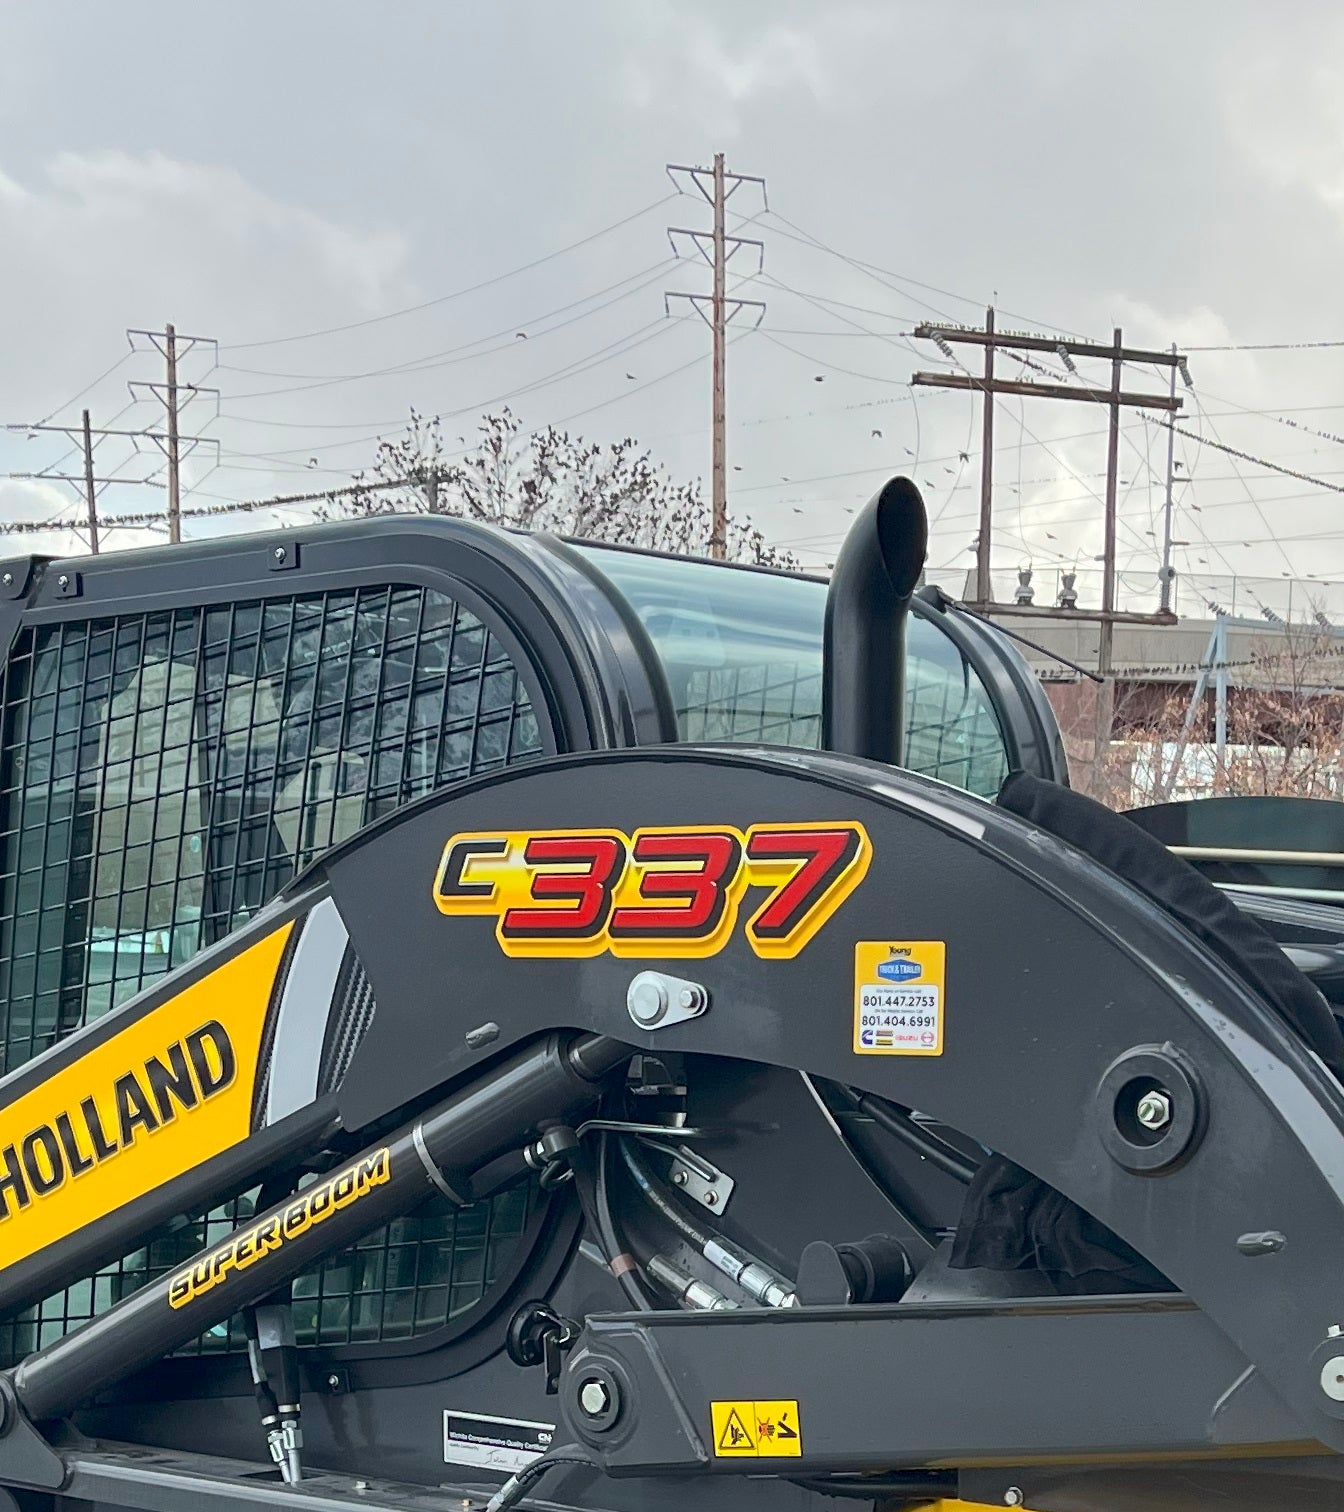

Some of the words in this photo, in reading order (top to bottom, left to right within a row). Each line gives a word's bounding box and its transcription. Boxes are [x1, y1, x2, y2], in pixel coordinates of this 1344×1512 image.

[434, 826, 868, 946] C337
[889, 945, 912, 956] Young
[863, 995, 935, 1007] 801.447.2753
[861, 1015, 935, 1027] 801.404.6991
[169, 1216, 283, 1309] SUPER
[284, 1148, 391, 1240] BOOM
